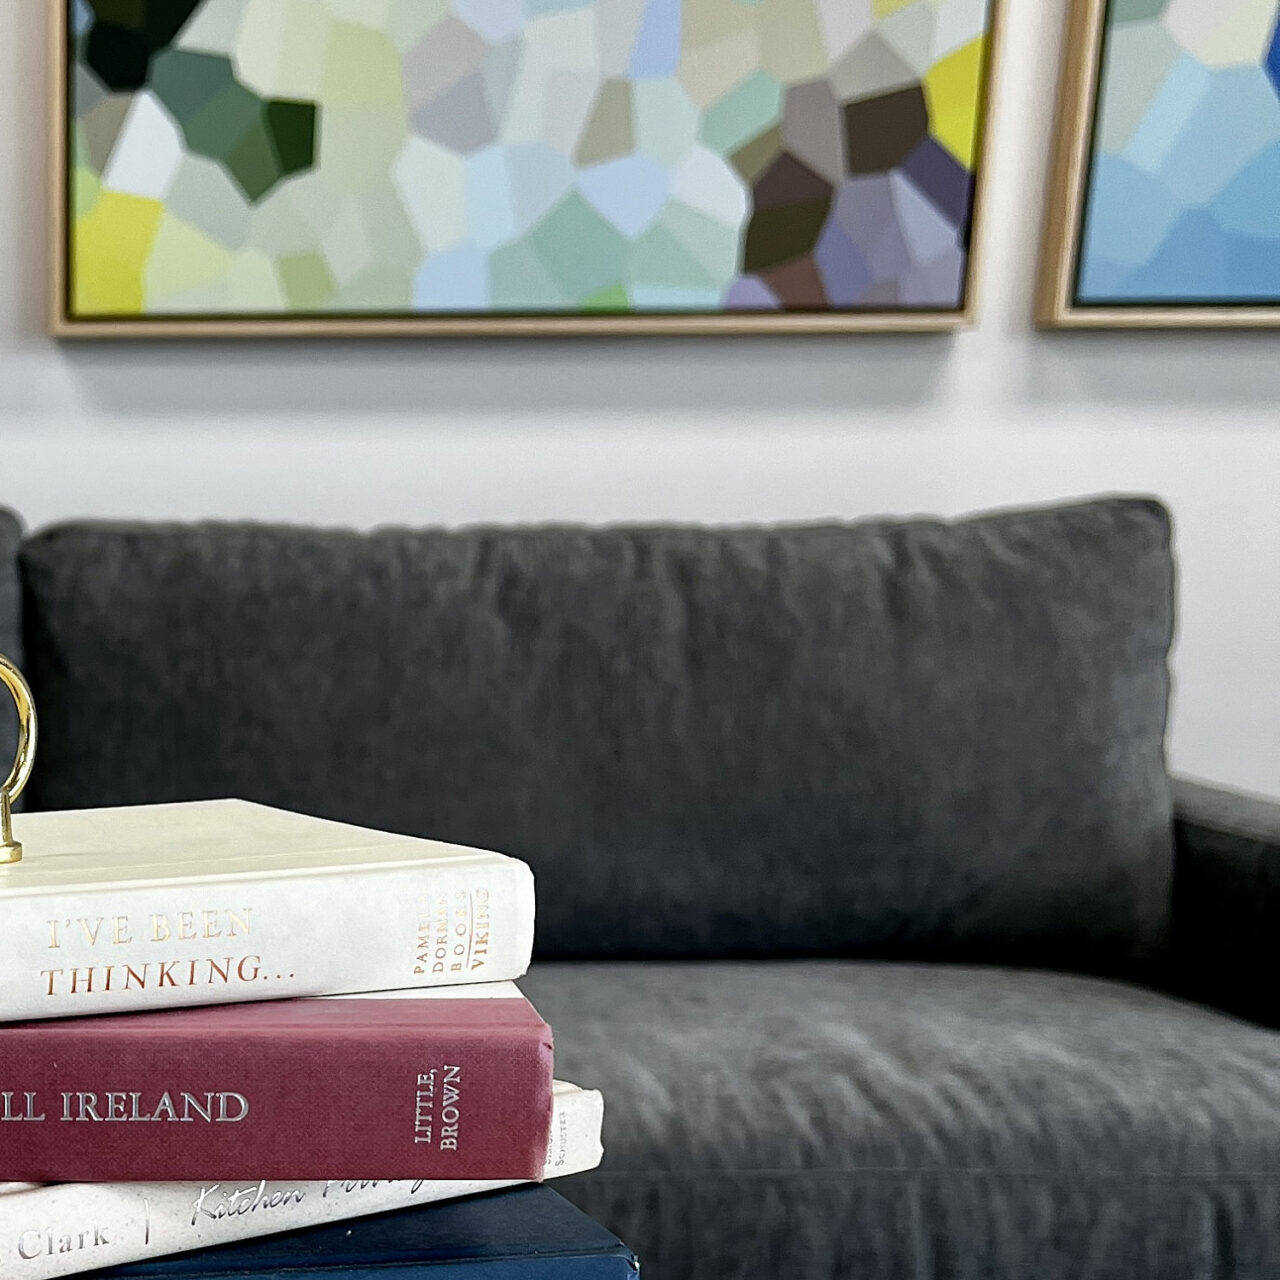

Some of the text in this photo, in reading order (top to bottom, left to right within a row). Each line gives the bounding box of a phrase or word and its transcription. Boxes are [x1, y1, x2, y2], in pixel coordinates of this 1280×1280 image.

[46, 907, 254, 950] I'VE BEEN
[450, 889, 467, 971] BOOKS
[471, 888, 490, 971] VIKING
[40, 954, 295, 997] THINKING...
[60, 1091, 249, 1123] IRELAND
[414, 1068, 438, 1144] LITTLE,
[440, 1065, 461, 1151] BROWN
[190, 1180, 306, 1226] Kitchen
[17, 1221, 111, 1260] Clark
